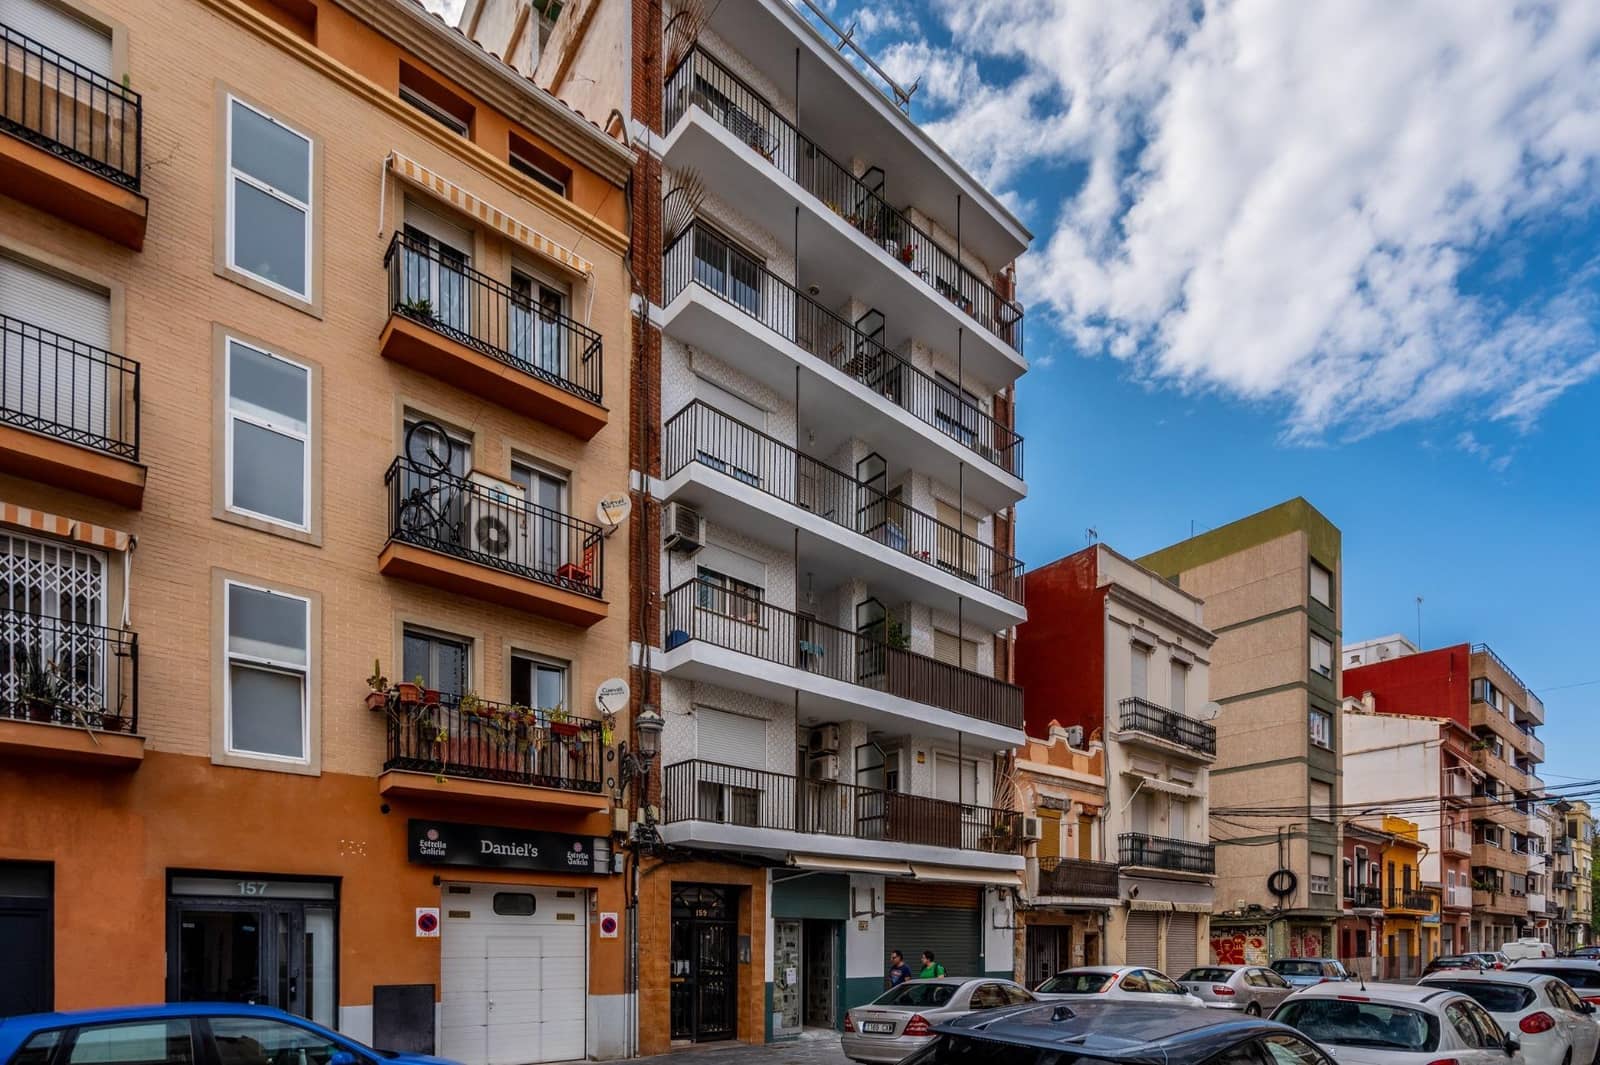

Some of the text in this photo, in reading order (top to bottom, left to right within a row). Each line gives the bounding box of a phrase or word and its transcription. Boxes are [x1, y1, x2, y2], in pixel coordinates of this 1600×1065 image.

[419, 840, 447, 849] Estrella
[480, 840, 538, 857] Daniel's
[420, 847, 446, 856] Galicia
[237, 881, 267, 896] 157
